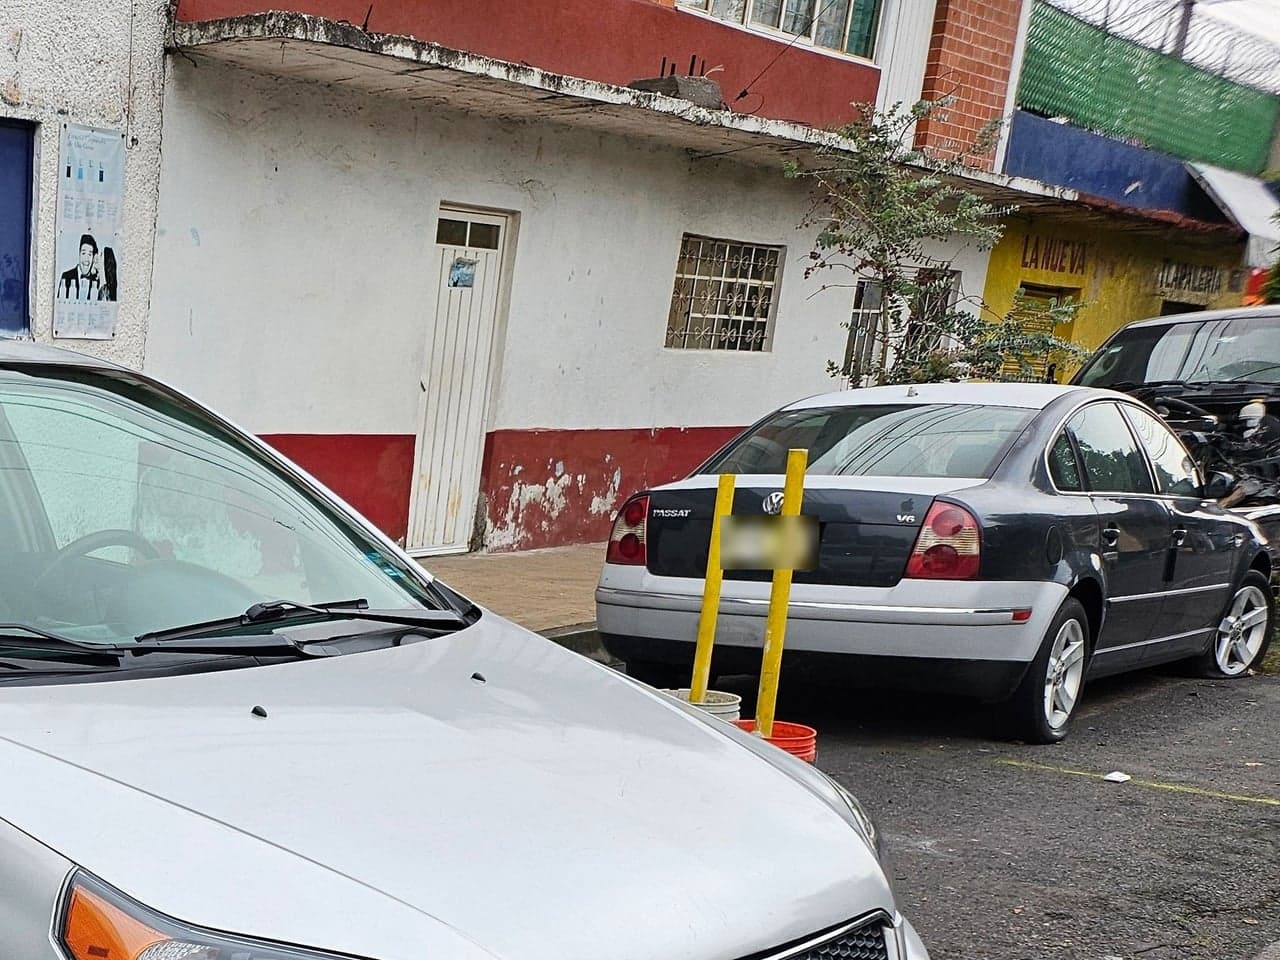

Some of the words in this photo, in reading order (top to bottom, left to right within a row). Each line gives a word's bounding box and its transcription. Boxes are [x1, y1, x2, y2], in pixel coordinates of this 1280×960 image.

[1021, 234, 1039, 269] LA
[1041, 238, 1086, 275] NUEVA
[653, 509, 692, 518] PASSAT
[896, 514, 915, 523] V6
